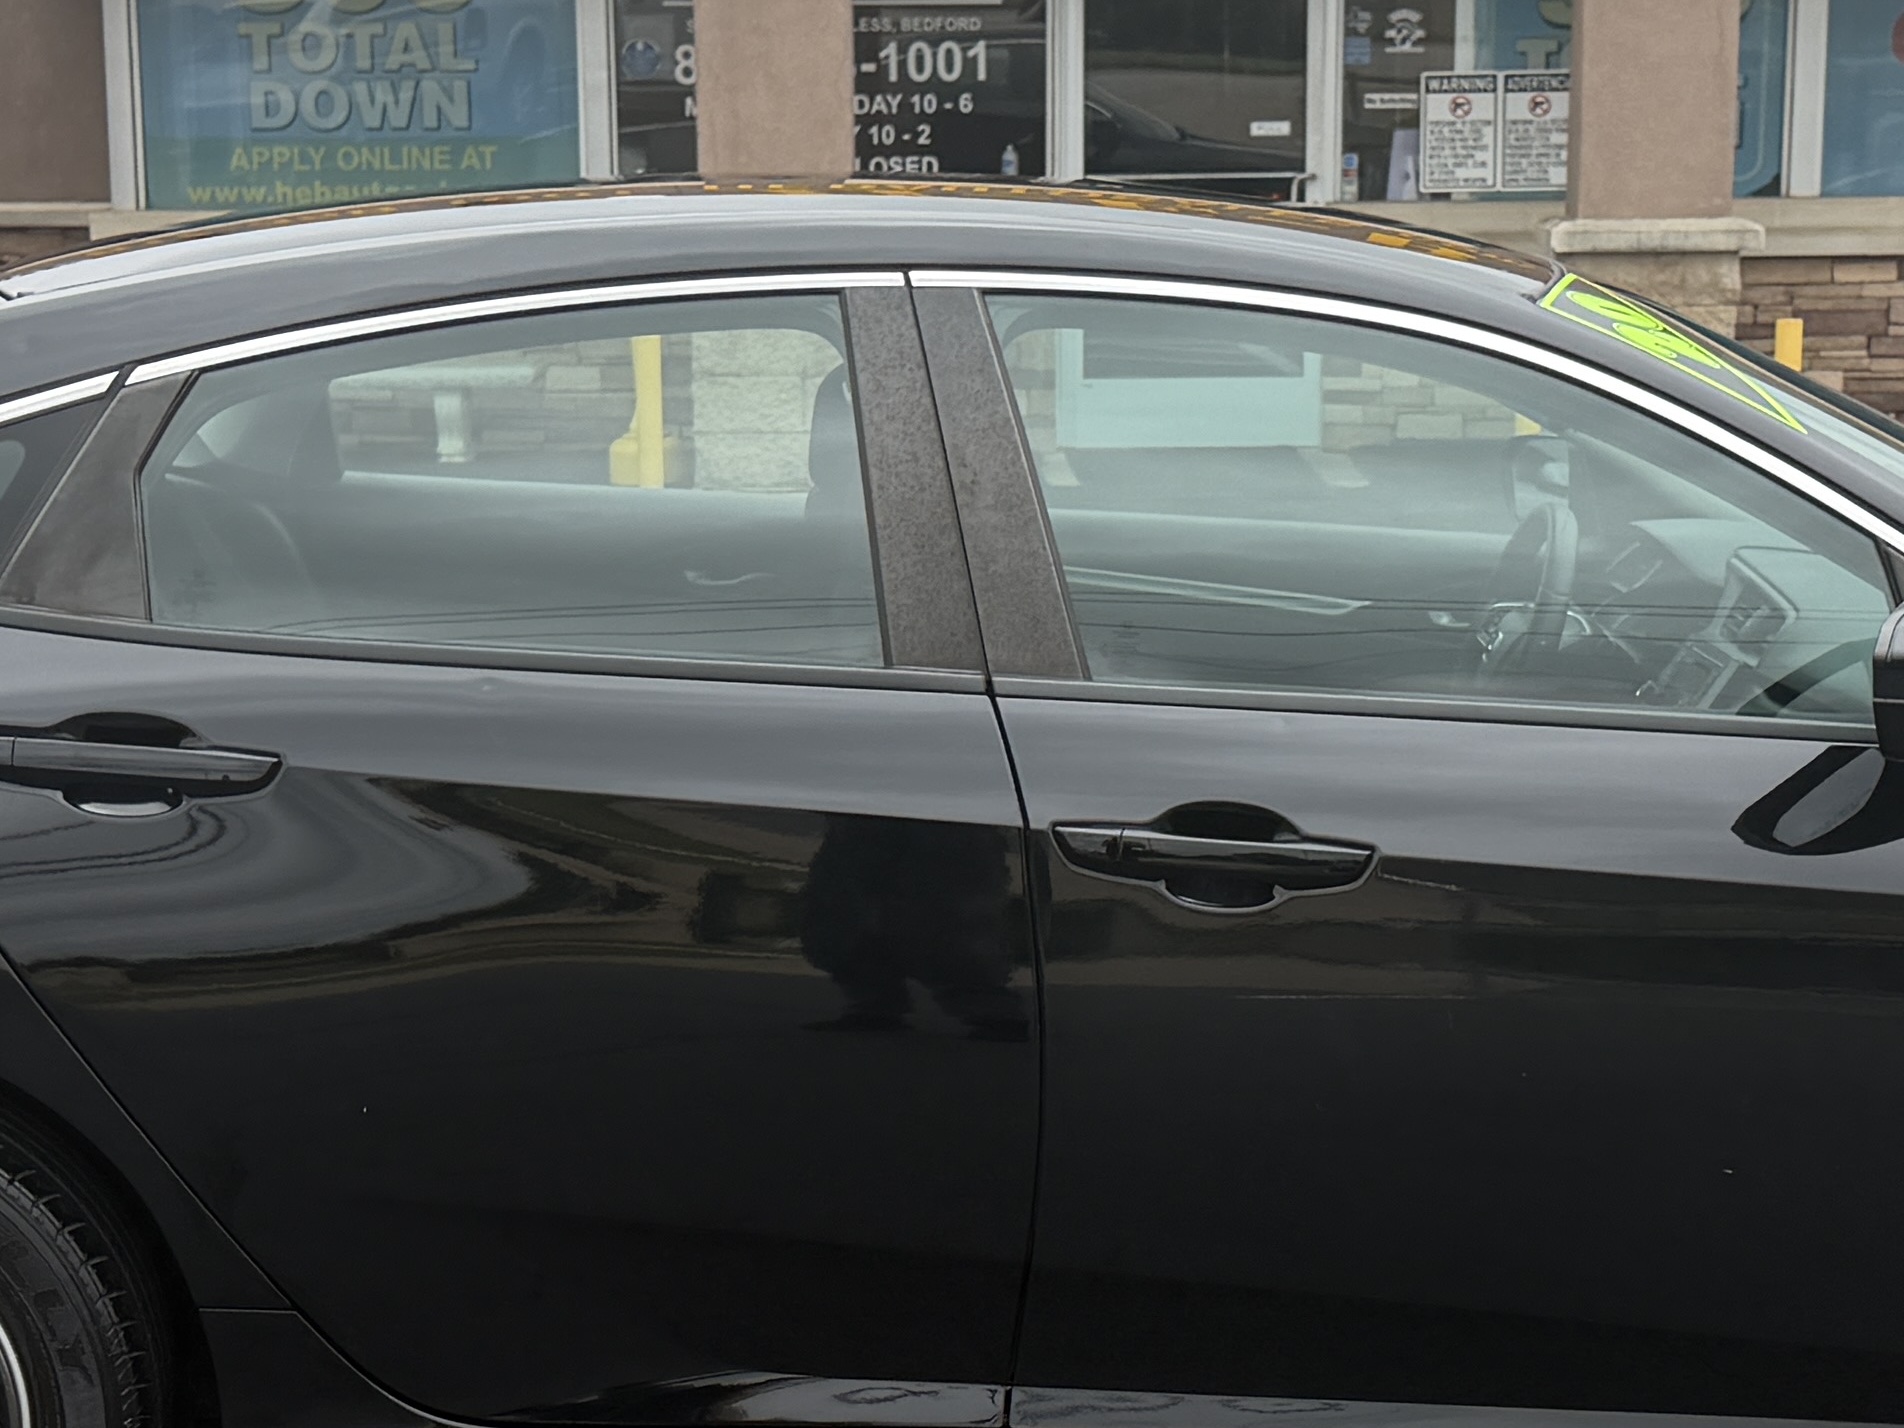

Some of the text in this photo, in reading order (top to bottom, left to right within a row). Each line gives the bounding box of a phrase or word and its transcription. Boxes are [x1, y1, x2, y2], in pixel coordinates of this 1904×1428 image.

[900, 16, 982, 32] BEDFORD
[237, 20, 479, 74] TOTAL
[1427, 76, 1496, 92] WARNING
[250, 78, 473, 133] DOWN
[910, 92, 937, 114] 10
[958, 92, 974, 114] 6
[868, 124, 896, 146] 10
[916, 123, 932, 145] 2
[229, 144, 499, 172] APPLY ONLINE AT
